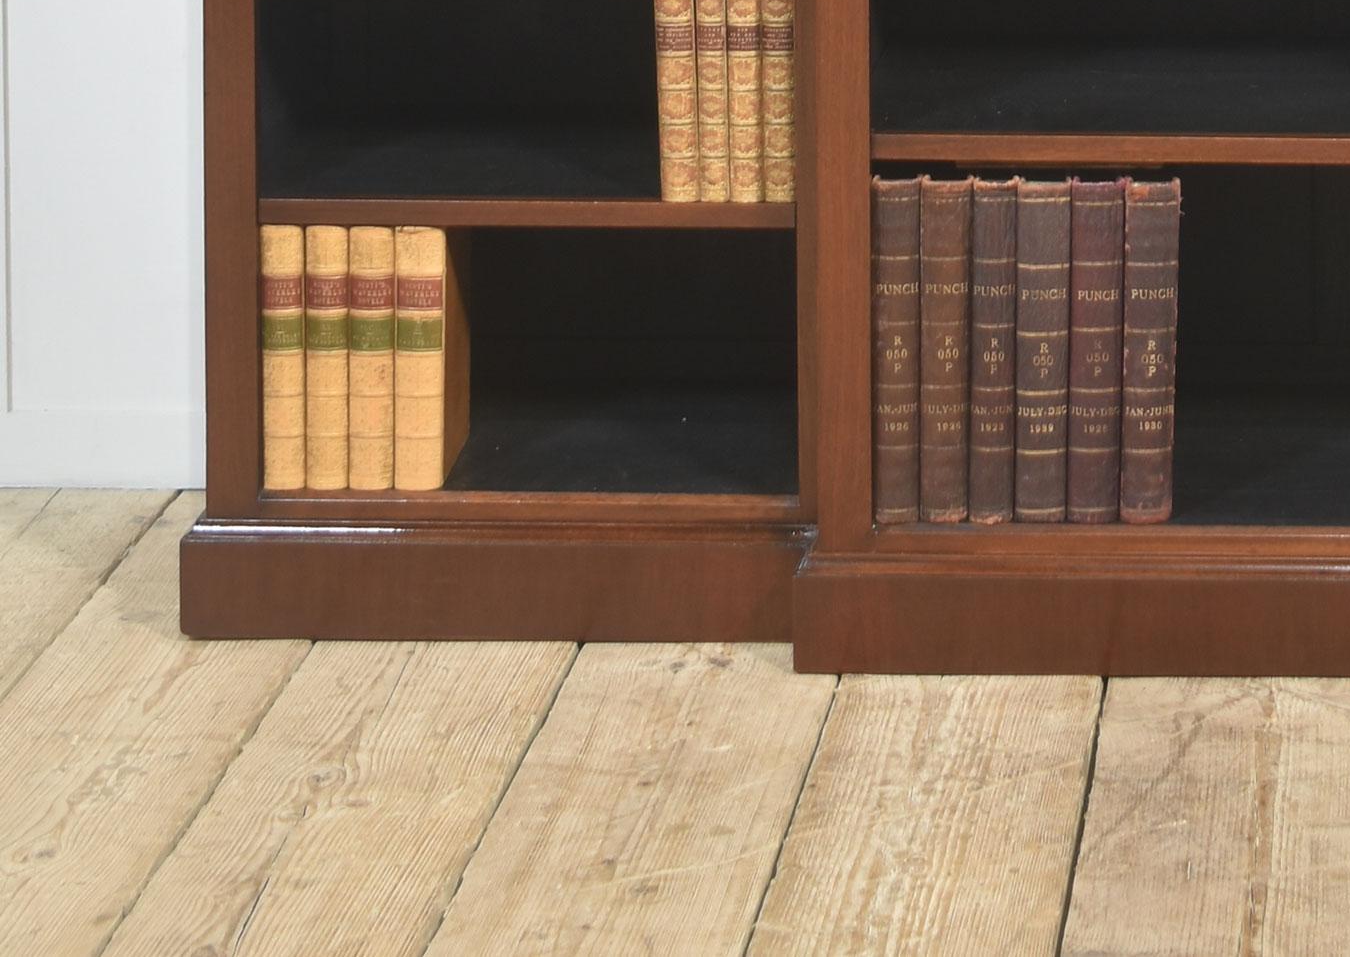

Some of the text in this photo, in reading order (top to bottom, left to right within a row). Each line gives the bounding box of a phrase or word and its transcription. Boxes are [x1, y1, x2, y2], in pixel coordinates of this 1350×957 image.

[877, 282, 919, 295] PUNCH
[925, 282, 968, 295] PUNCH
[974, 284, 1016, 297] PUNCH
[1022, 288, 1066, 300] PUNCH
[1131, 287, 1174, 300] PUNCH
[1077, 289, 1119, 302] PUNCH
[894, 362, 902, 373] P
[945, 362, 953, 372] P
[990, 364, 998, 375] P
[1094, 367, 1102, 377] P
[1148, 366, 1157, 377] P
[1040, 368, 1049, 378] P
